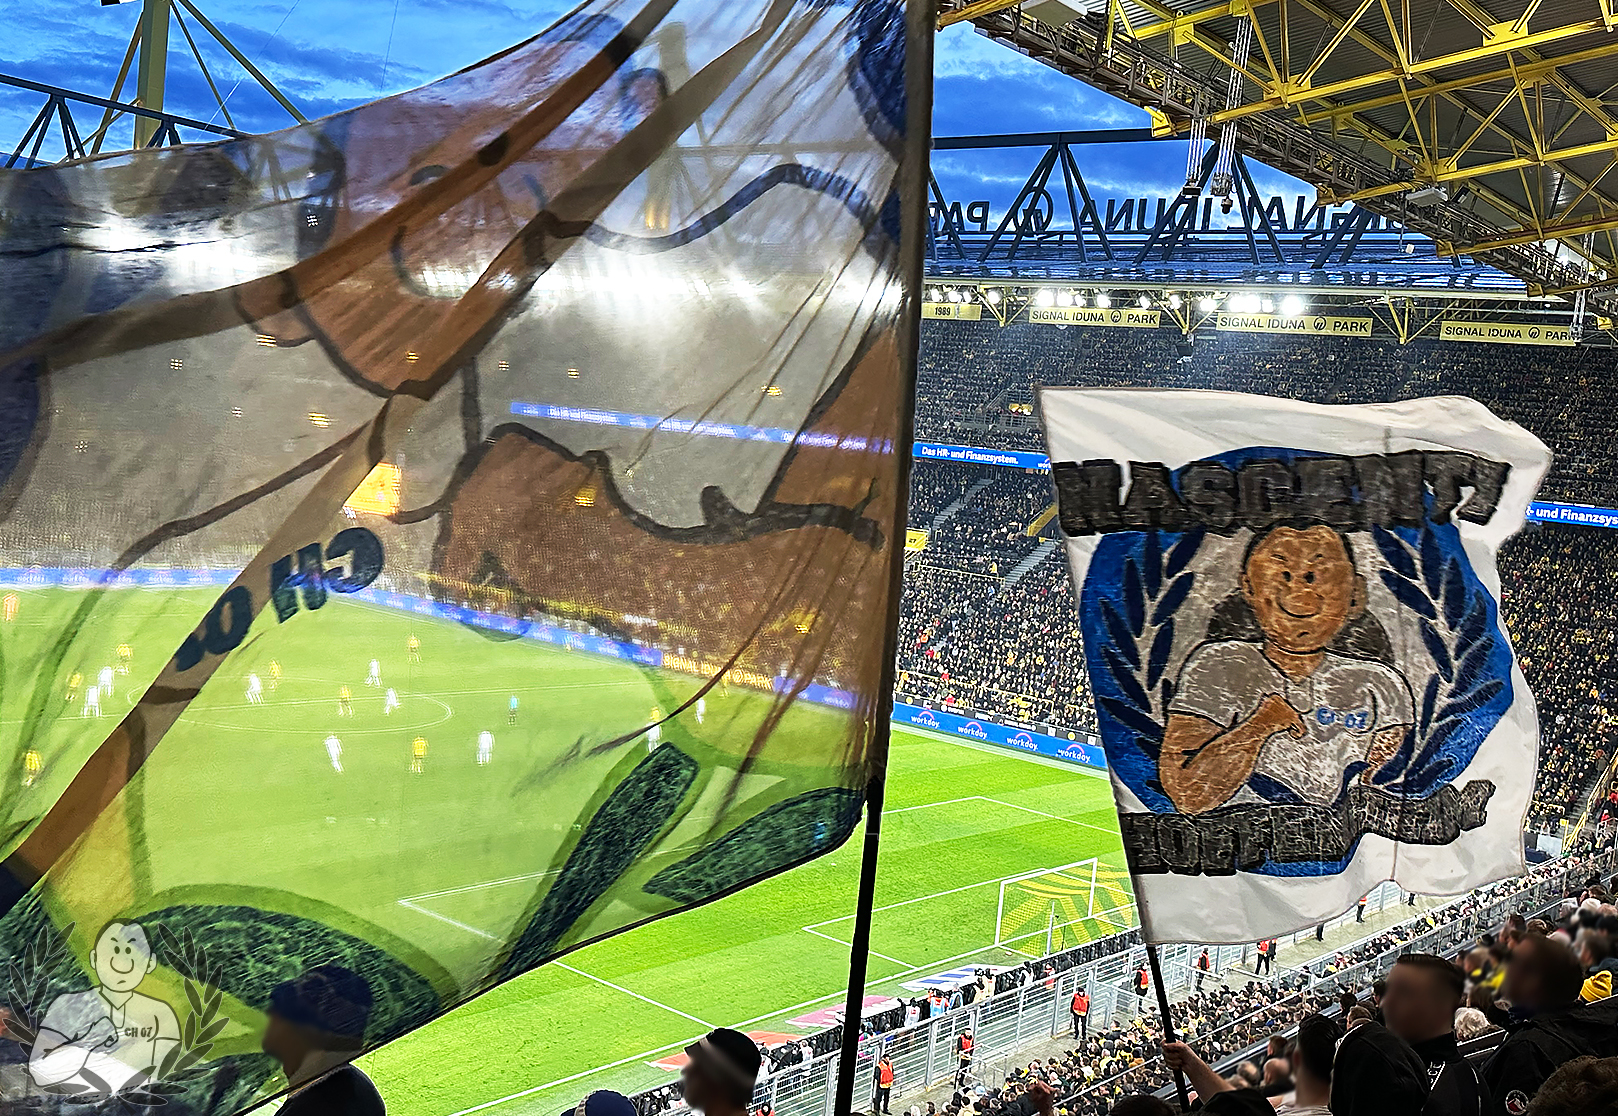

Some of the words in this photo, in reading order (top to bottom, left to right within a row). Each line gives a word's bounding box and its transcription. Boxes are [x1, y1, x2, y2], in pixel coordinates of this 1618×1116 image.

[1032, 309, 1069, 321] SIGNAL
[1072, 310, 1105, 322] IDUNA
[1127, 313, 1157, 324] PARK
[1220, 316, 1264, 328] SIGNAL
[1267, 318, 1305, 330] IDUNA
[1333, 321, 1369, 332] PARK
[1445, 326, 1485, 337] SIGNAL
[1487, 328, 1522, 338] IDUNA
[921, 446, 936, 456] Das
[1535, 508, 1559, 519] und
[663, 653, 700, 673] SIGNAL
[745, 673, 773, 690] PARK
[911, 716, 940, 729] workday
[958, 726, 988, 739] workday
[1006, 737, 1038, 751] workday
